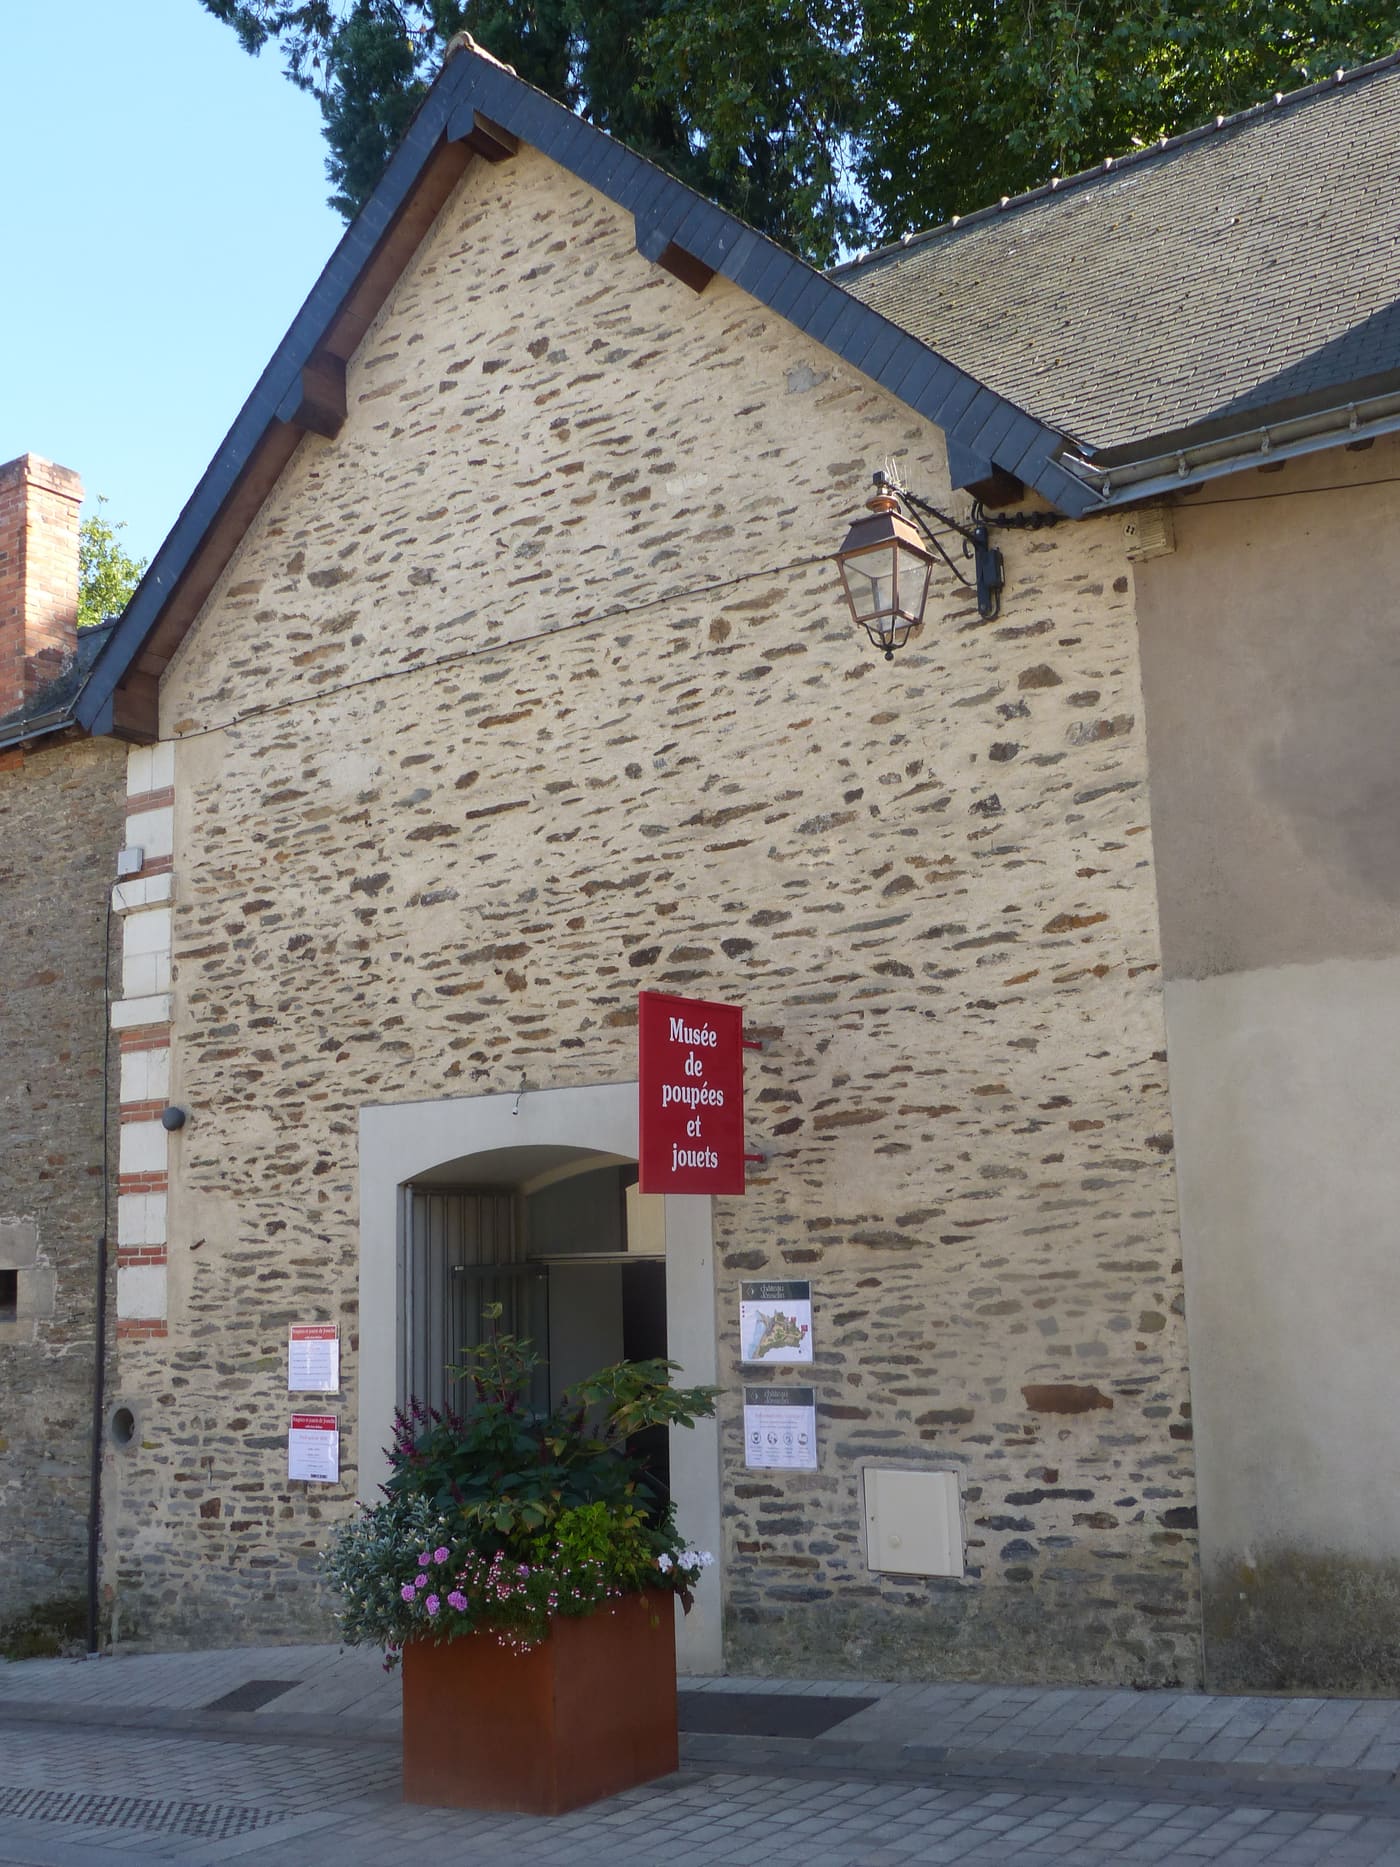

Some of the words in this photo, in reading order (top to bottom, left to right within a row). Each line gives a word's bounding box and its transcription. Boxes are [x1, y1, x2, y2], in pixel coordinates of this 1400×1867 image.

[669, 1016, 717, 1047] Musée
[684, 1051, 703, 1076] de
[662, 1081, 724, 1110] poupées
[686, 1115, 702, 1137] et
[671, 1143, 718, 1172] jouets
